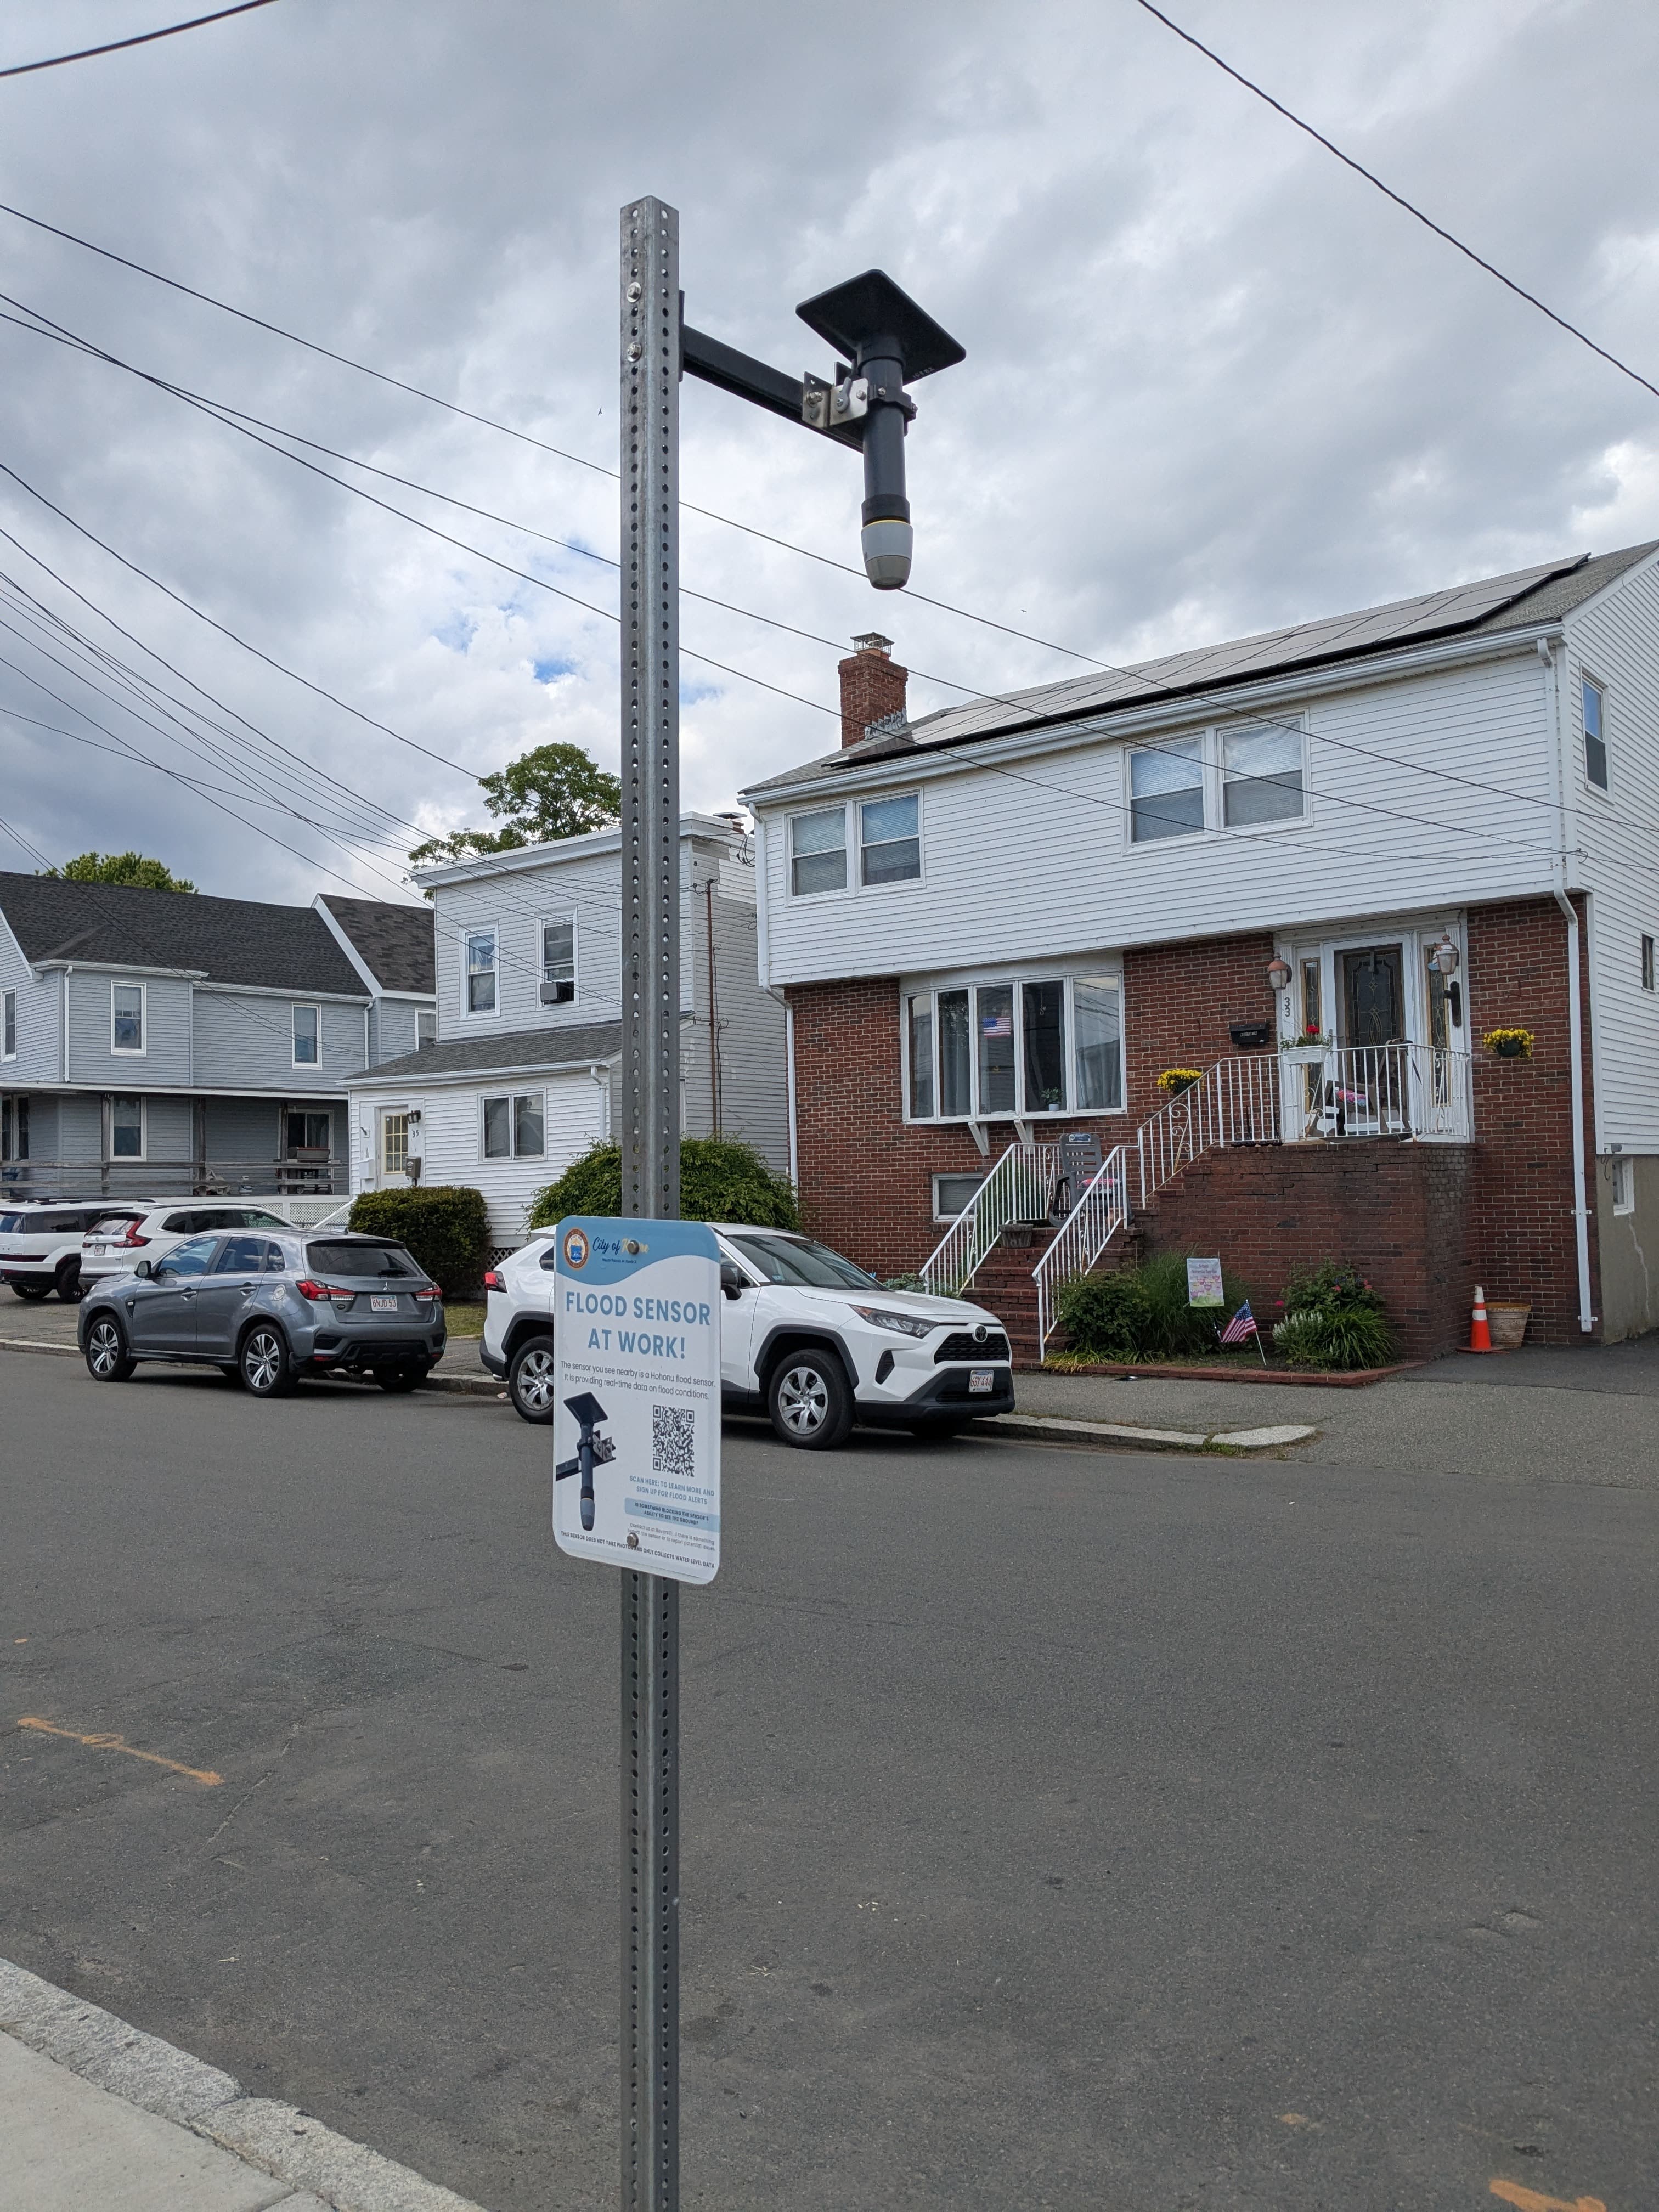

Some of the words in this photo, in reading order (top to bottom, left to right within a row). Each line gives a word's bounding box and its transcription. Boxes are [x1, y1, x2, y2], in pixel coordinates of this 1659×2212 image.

[1284, 997, 1291, 1017] 33
[593, 1237, 610, 1254] City
[612, 1240, 620, 1255] of
[373, 1299, 387, 1307] 6NJD
[388, 1299, 396, 1307] 53
[566, 1291, 627, 1317] FLOOD
[633, 1297, 710, 1325] SENSOR
[588, 1328, 612, 1350] AT
[618, 1331, 685, 1359] WORK!
[561, 1361, 571, 1369] The
[572, 1363, 591, 1372] sensor
[592, 1366, 603, 1375] you
[617, 1368, 637, 1379] nearby
[639, 1369, 644, 1378] is
[651, 1372, 674, 1383] Hohonu
[676, 1374, 692, 1385] flood
[693, 1378, 716, 1387] sensor.
[970, 1376, 981, 1387] 6SX
[981, 1376, 992, 1387] 444
[575, 1375, 602, 1387] providing
[604, 1378, 632, 1389] real-time
[633, 1383, 647, 1392] data
[658, 1385, 674, 1395] flood
[675, 1388, 709, 1400] conditions.
[669, 1482, 685, 1491] LEARN
[687, 1486, 701, 1494] MORE
[669, 1492, 686, 1501] FLOOD
[688, 1496, 707, 1505] ALERTS
[654, 1550, 675, 1560] COLLECTS
[675, 1555, 690, 1563] WATER
